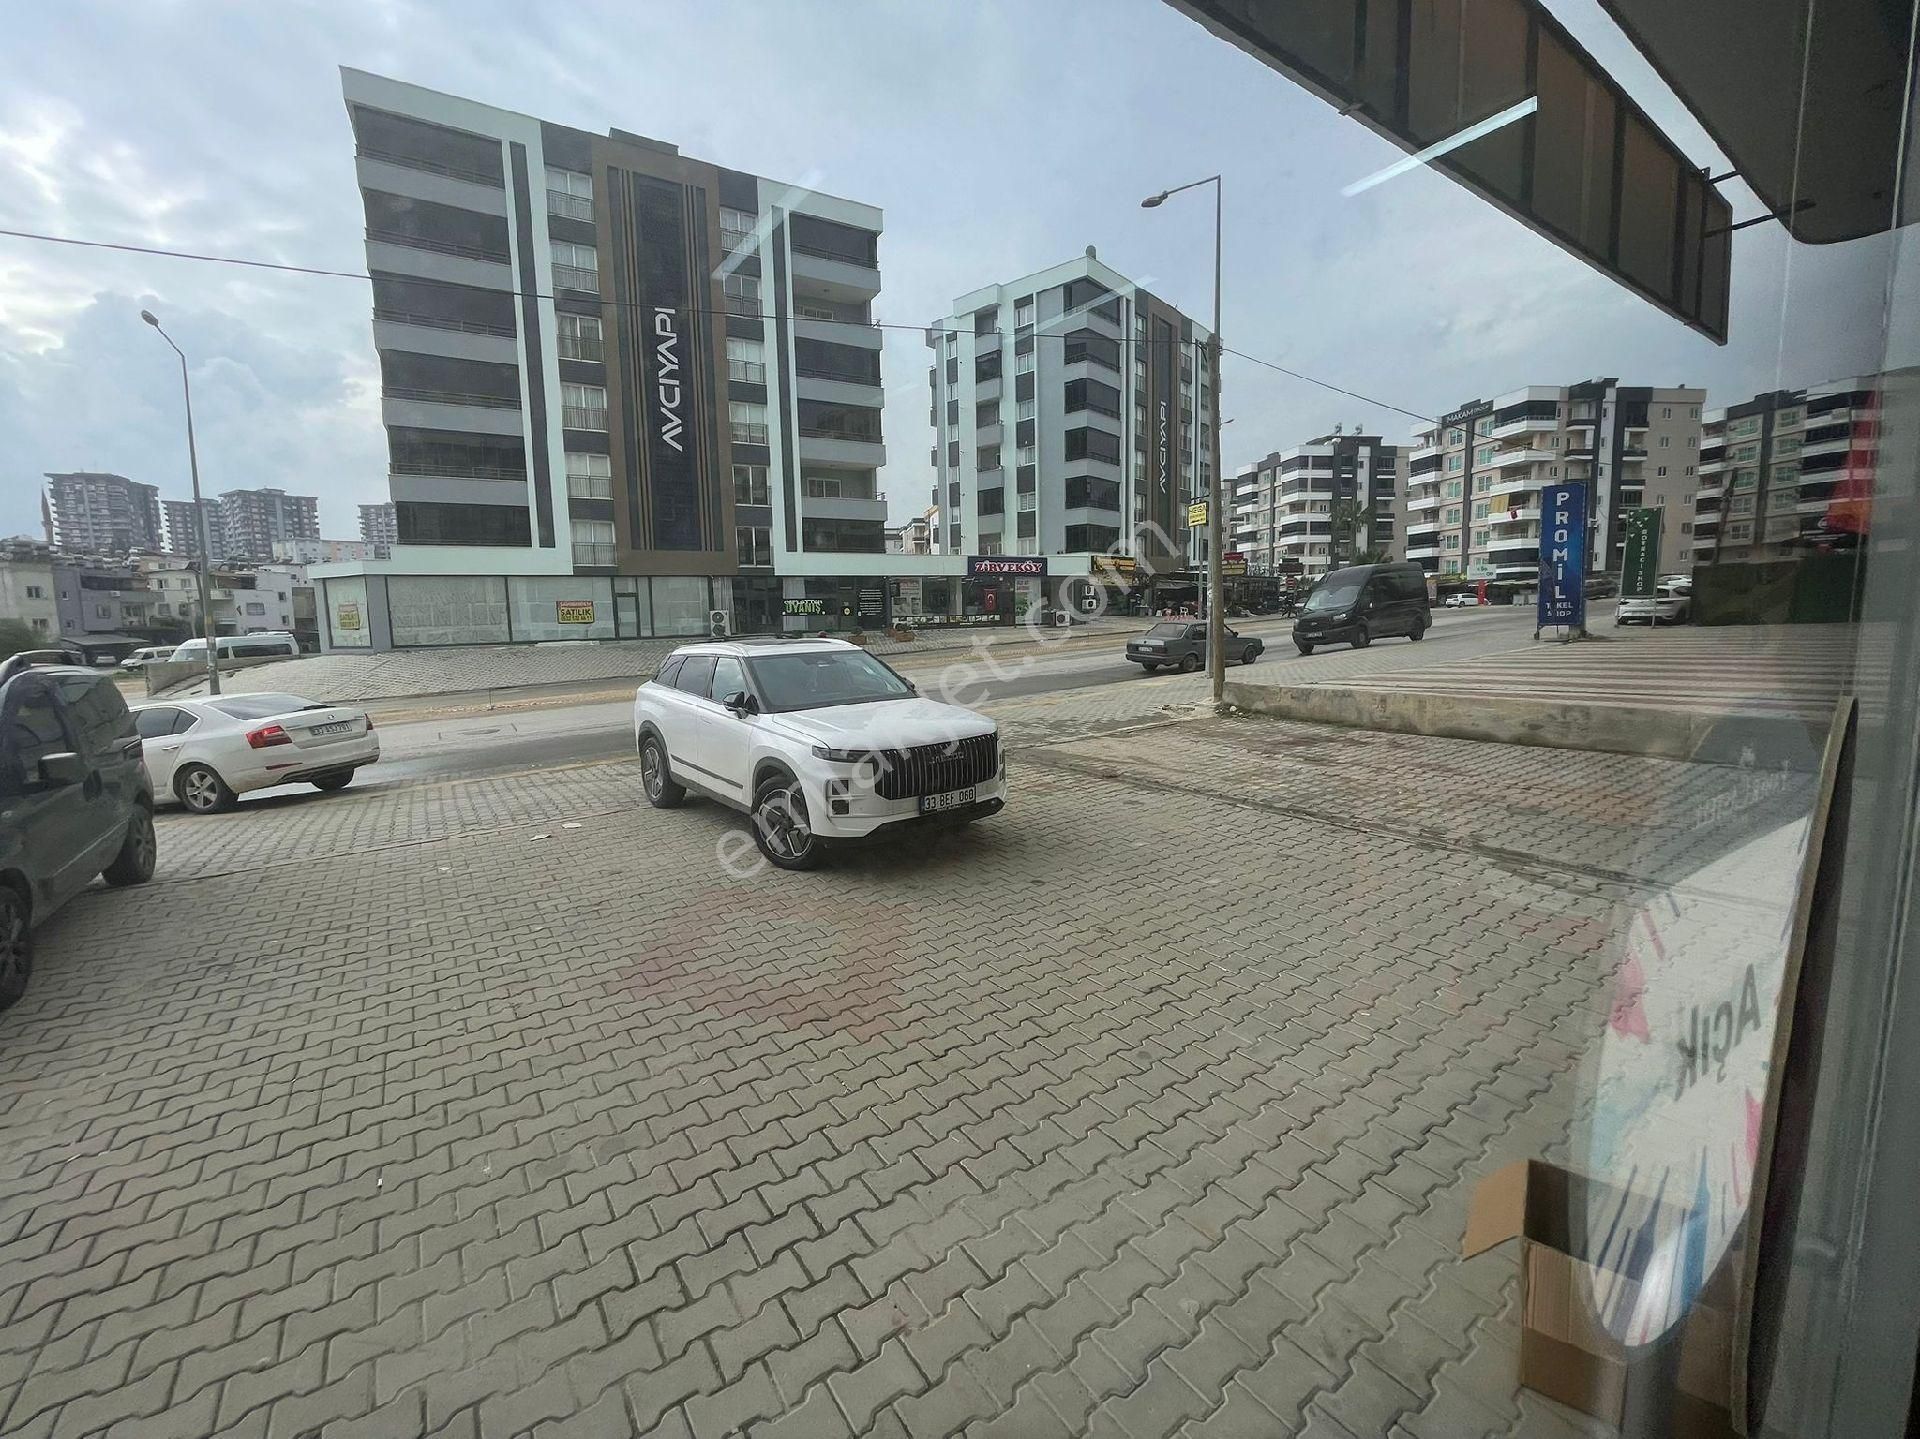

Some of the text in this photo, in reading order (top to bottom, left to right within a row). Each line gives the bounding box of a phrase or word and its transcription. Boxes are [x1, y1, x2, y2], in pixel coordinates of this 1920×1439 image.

[654, 307, 683, 452] AVCIYAPI
[1552, 492, 1570, 599] PROMİL
[560, 608, 592, 616] SATILIK
[925, 797, 936, 809] 33
